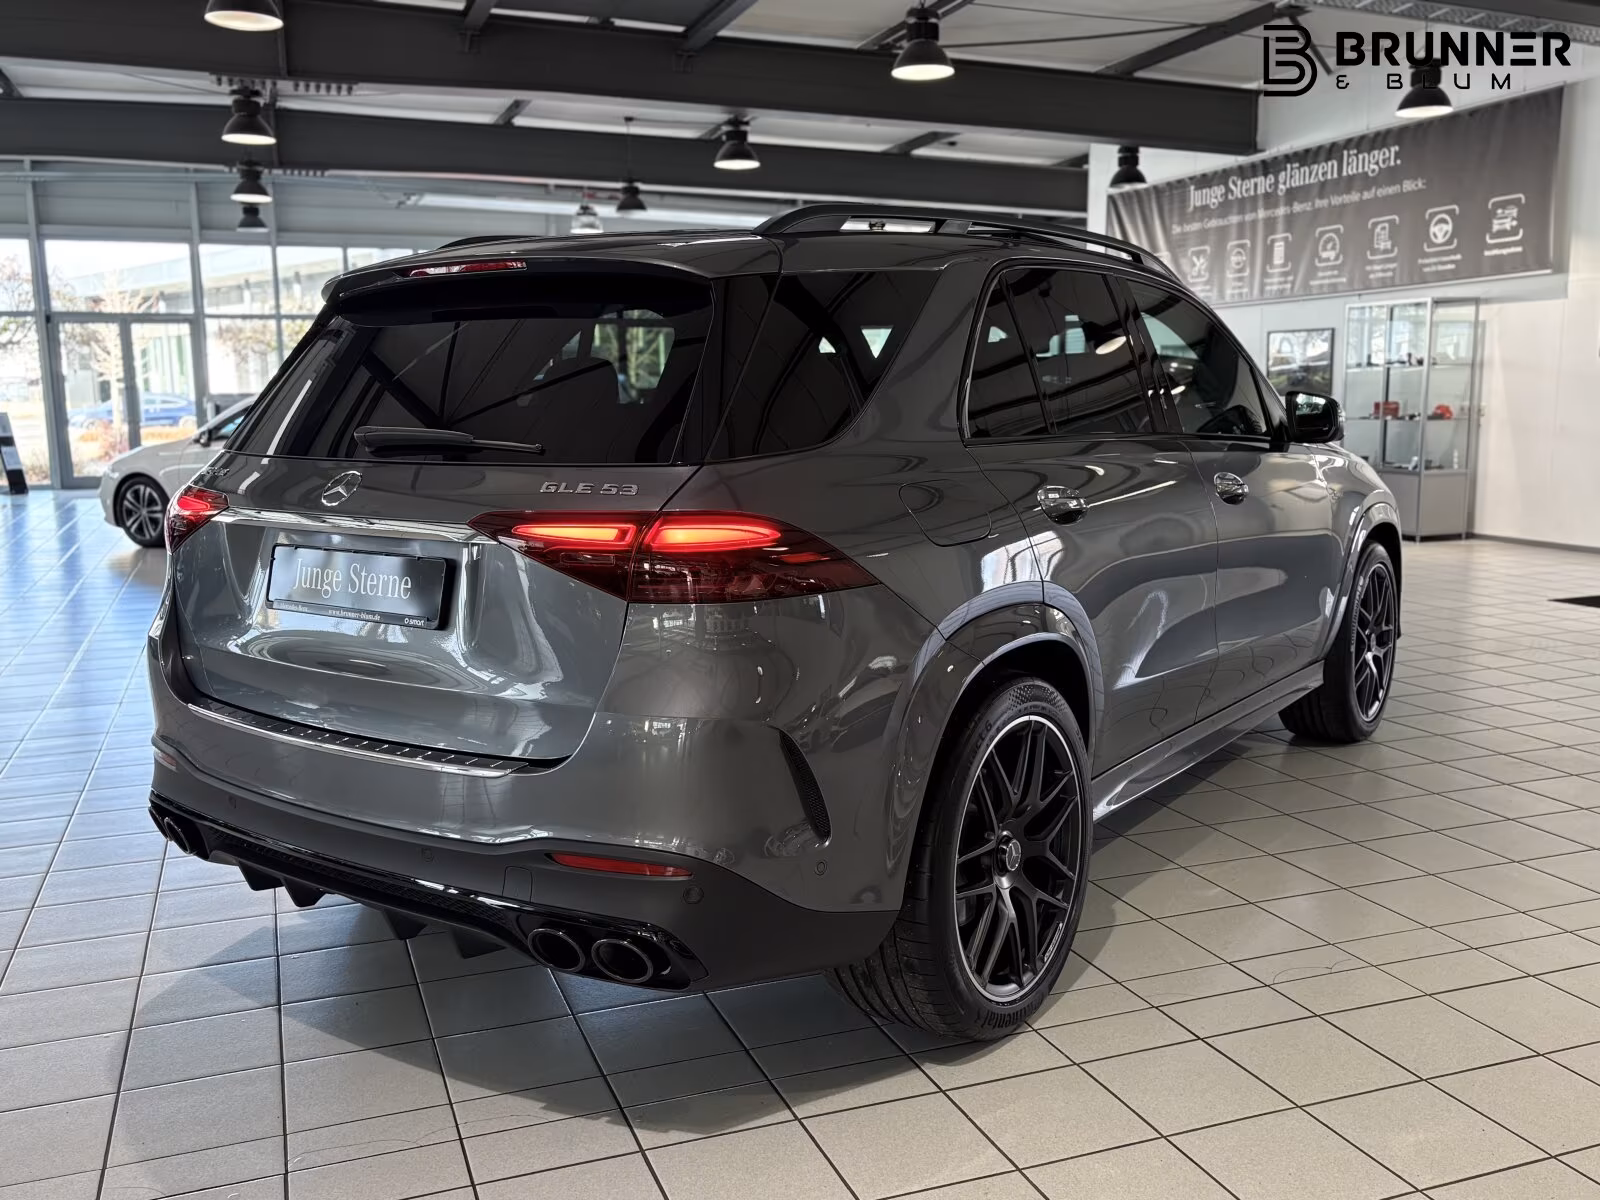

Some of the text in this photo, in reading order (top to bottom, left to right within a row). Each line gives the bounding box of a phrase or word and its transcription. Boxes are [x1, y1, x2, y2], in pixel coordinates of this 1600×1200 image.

[1187, 145, 1402, 212] Junge Sterne glänzen länger.
[1362, 186, 1376, 200] auf
[1376, 184, 1401, 198] einen
[540, 481, 639, 495] GLE 53
[292, 558, 412, 600] Junge Sterne
